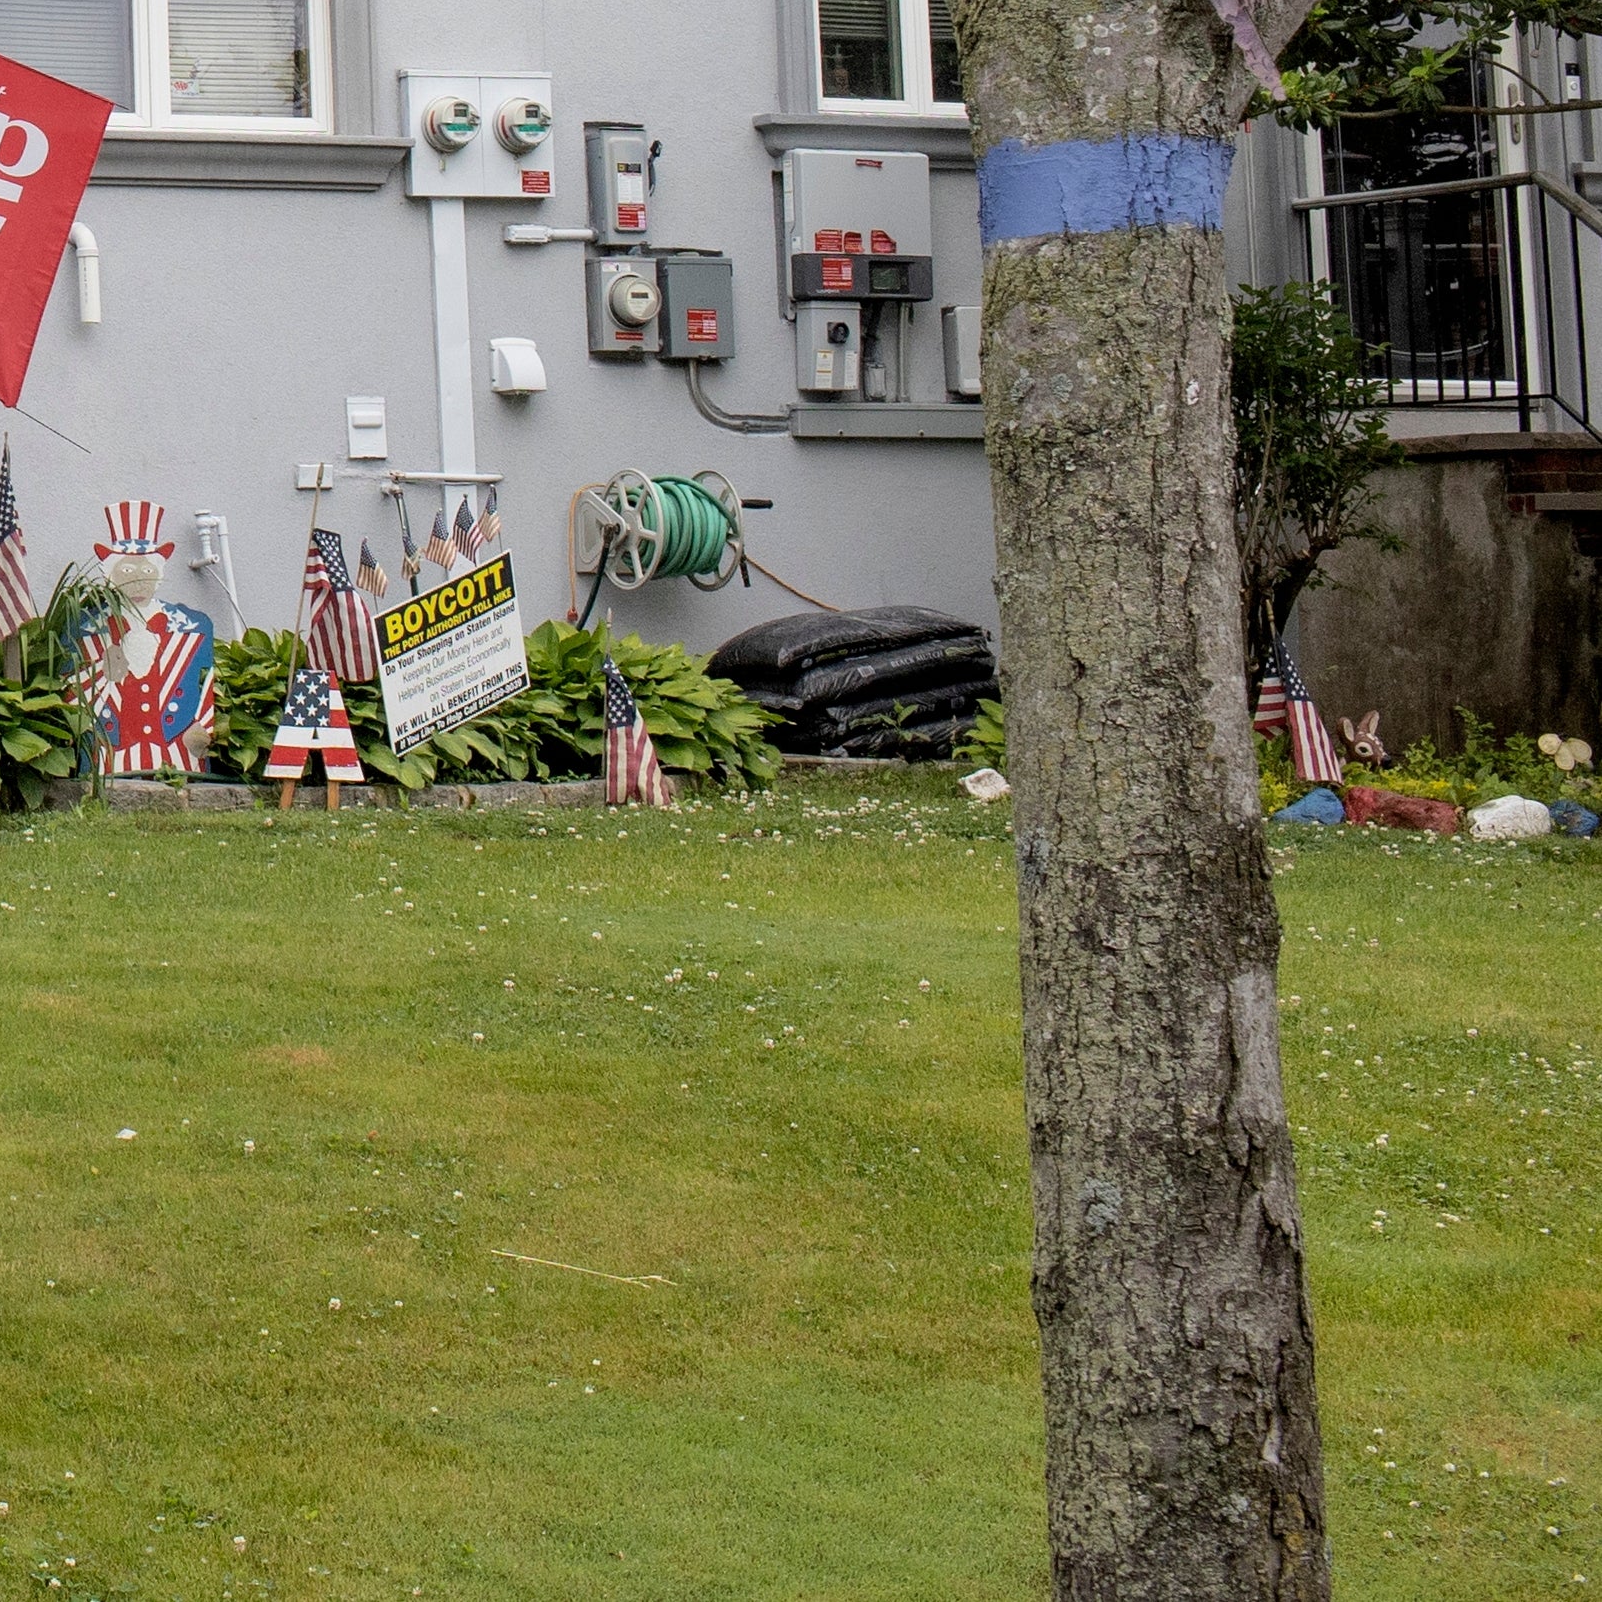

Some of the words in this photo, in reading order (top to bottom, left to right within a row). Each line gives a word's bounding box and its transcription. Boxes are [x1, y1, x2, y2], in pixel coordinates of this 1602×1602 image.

[384, 642, 401, 659] THE
[402, 631, 424, 650] PORT
[426, 608, 472, 639] AUTHORITY
[473, 599, 493, 615] TOLL
[493, 587, 512, 605] HIKE
[385, 560, 504, 643] BOYCOTT
[385, 664, 396, 676] Do
[397, 653, 415, 669] Your
[417, 636, 453, 660] Shopping
[455, 630, 465, 641] on
[467, 615, 492, 635] Staten
[493, 602, 516, 621] Island
[398, 681, 424, 702] Helping
[426, 662, 466, 688] Businesses
[467, 637, 511, 667] Economically
[402, 662, 431, 683] Keeping
[432, 655, 445, 669] Our
[447, 641, 471, 661] Money
[472, 633, 490, 648] Here
[491, 625, 503, 639] and
[396, 723, 408, 736] WE
[410, 712, 428, 728] WILL
[431, 703, 445, 718] ALL
[448, 685, 479, 709] BENEFIT
[481, 675, 504, 693] FROM
[505, 662, 522, 678] THIS
[429, 692, 439, 702] on
[441, 679, 464, 697] Staten
[465, 667, 486, 685] Island
